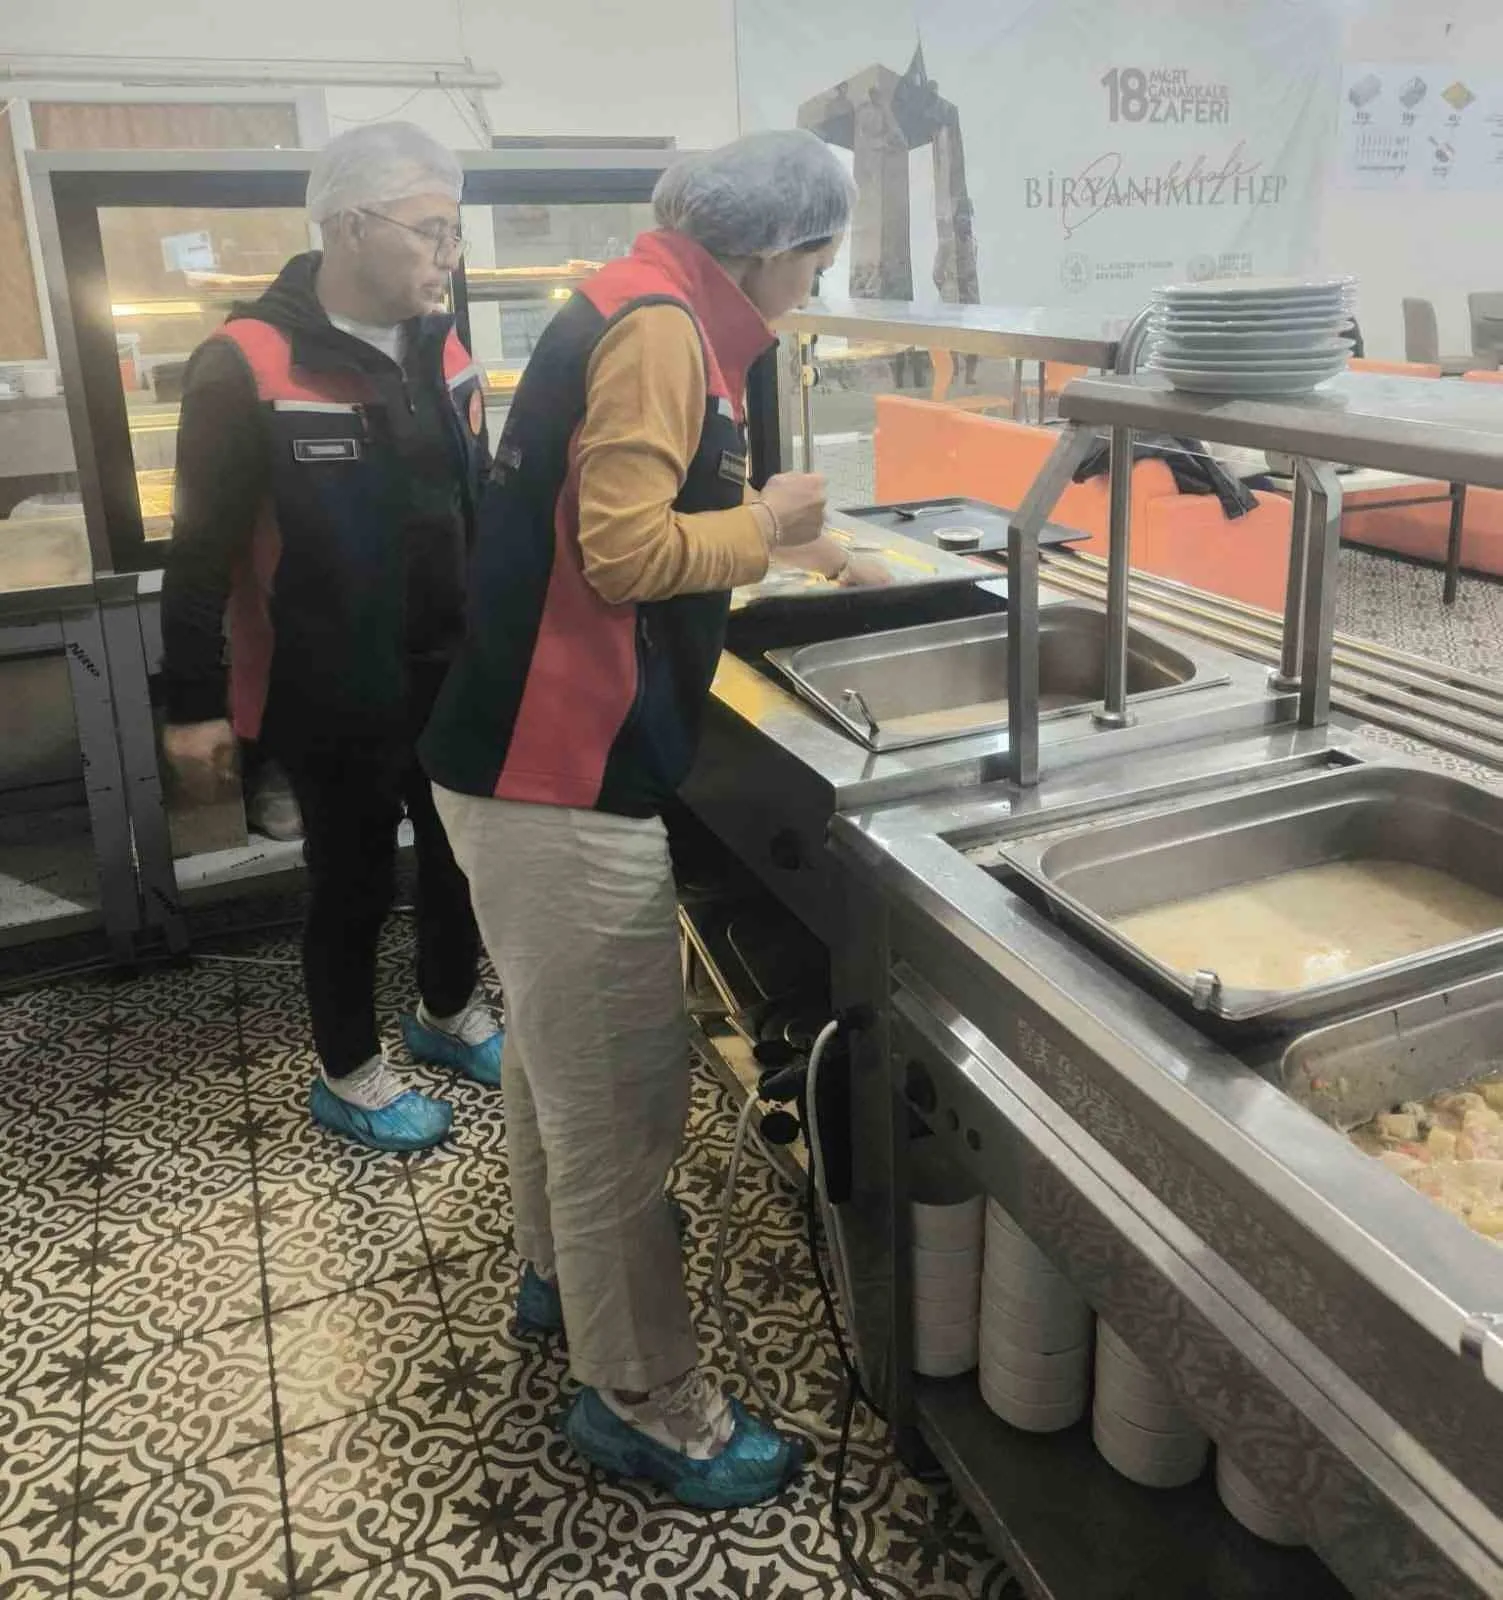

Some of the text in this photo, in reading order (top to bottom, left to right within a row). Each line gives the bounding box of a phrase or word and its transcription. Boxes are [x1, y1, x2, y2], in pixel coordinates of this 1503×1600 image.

[1100, 67, 1149, 122] 18
[1149, 98, 1230, 123] ZAFERİ
[1024, 170, 1081, 208] BİR
[1233, 175, 1287, 206] HEP
